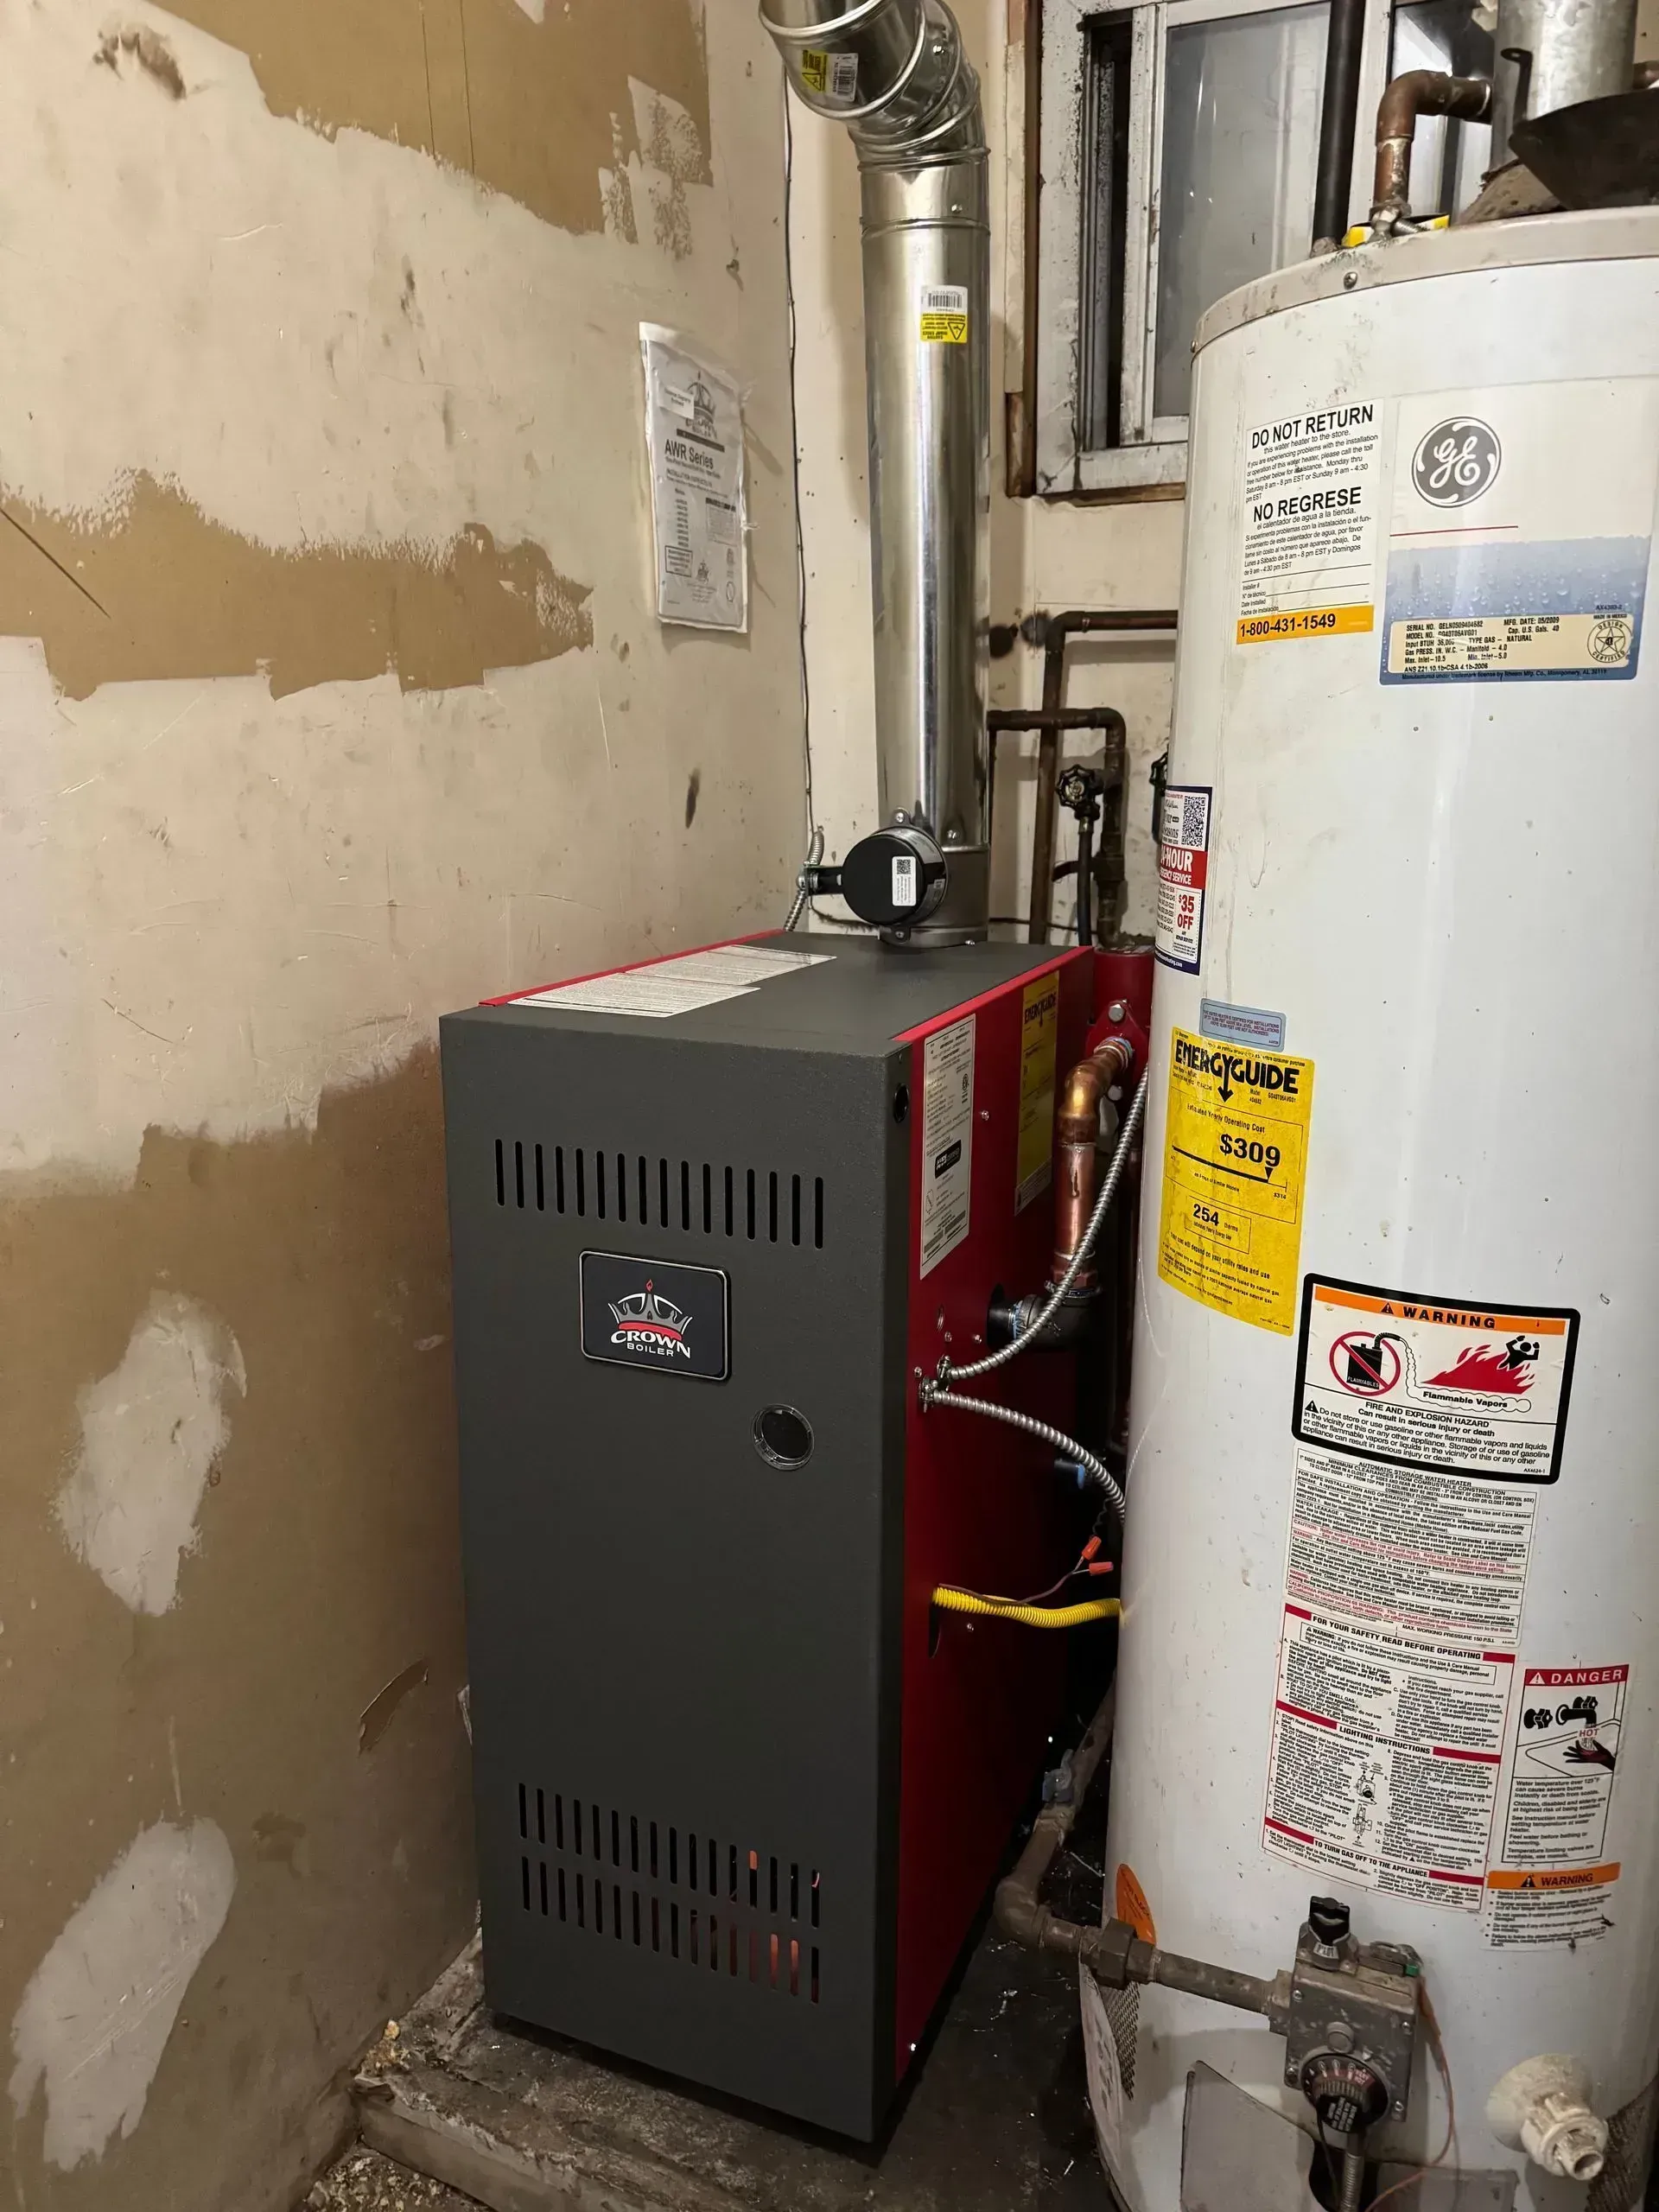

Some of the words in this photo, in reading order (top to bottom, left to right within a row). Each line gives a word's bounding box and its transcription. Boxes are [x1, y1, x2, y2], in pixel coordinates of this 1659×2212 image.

[1252, 429, 1269, 449] DO
[1273, 420, 1301, 442] NOT
[1306, 405, 1373, 434] RETURN
[1267, 450, 1296, 462] experiencing
[1297, 445, 1321, 455] problems
[1346, 434, 1378, 445] installation
[1275, 442, 1290, 451] water
[1291, 438, 1310, 448] heater
[1332, 430, 1350, 439] store.
[665, 439, 687, 460] AWR
[689, 447, 713, 469] Series
[1254, 503, 1273, 522] NO
[1278, 486, 1361, 517] REGRESE
[1263, 518, 1291, 529] calentador
[1302, 513, 1317, 522] agua
[1333, 507, 1356, 516] tienda.
[1241, 613, 1335, 637] 1-800-431-1549
[1598, 621, 1623, 629] DESIGN
[1592, 650, 1625, 661] CERTIFIED
[1173, 873, 1191, 885] SERVICE
[1178, 894, 1194, 913] $35
[1177, 914, 1194, 930] OFF
[1176, 1039, 1300, 1094] ENERGYGUIDE
[1224, 1117, 1250, 1130] Operating
[1252, 1123, 1265, 1133] Cost
[1219, 1133, 1281, 1167] $309
[1193, 1203, 1219, 1227] 254
[1224, 1222, 1238, 1232] therms
[1212, 1253, 1221, 1263] your
[1222, 1258, 1235, 1268] utility
[1236, 1263, 1248, 1273] rates
[1250, 1267, 1259, 1276] and
[1403, 1306, 1496, 1329] WARNING
[611, 1330, 690, 1358] CROWN
[627, 1342, 674, 1357] BOILER
[1423, 1391, 1473, 1404] Flammable
[1476, 1398, 1508, 1408] Vapors
[1358, 1408, 1373, 1417] Can
[1376, 1412, 1397, 1422] result
[1408, 1420, 1436, 1429] serious
[1439, 1424, 1460, 1434] injury
[1473, 1428, 1495, 1436] death
[1366, 1401, 1383, 1411] FIRE
[1386, 1406, 1403, 1415] AND
[1405, 1410, 1452, 1423] EXPLOSION
[1455, 1418, 1490, 1428] HAZARD
[1320, 1407, 1329, 1415] Do
[1343, 1414, 1360, 1423] store
[1385, 1424, 1414, 1435] gasoline
[1445, 1434, 1482, 1445] flammable
[1484, 1440, 1508, 1449] vapors
[1323, 1416, 1345, 1427] vicinity
[1391, 1433, 1409, 1441] other
[1411, 1436, 1446, 1449] appliance.
[1449, 1443, 1477, 1452] Storage
[1303, 1425, 1333, 1438] appliance
[1349, 1437, 1367, 1447] result
[1377, 1443, 1402, 1454] serious
[1403, 1447, 1422, 1459] injury
[1359, 1462, 1393, 1474] AUTOMATIC
[1394, 1469, 1423, 1480] STORAGE
[1425, 1476, 1446, 1484] WATER
[1313, 1616, 1327, 1626] FOR
[1330, 1621, 1349, 1633] YOUR
[1351, 1626, 1380, 1640] SAFETY
[1382, 1636, 1402, 1646] READ
[1405, 1642, 1435, 1653] BEFORE
[1437, 1647, 1481, 1659] OPERATING
[1417, 1627, 1442, 1636] WORKING
[1444, 1632, 1472, 1641] PRESSURE
[1551, 1669, 1623, 1684] DANGER
[1339, 1726, 1373, 1741] LIGHTING
[1375, 1736, 1430, 1754] INSTRUCTIONS
[1579, 1728, 1599, 1737] HOT
[1324, 1843, 1340, 1854] TURN
[1342, 1848, 1354, 1858] GAS
[1392, 1865, 1428, 1877] APPLIANCE
[1541, 1873, 1593, 1887] WARNING
